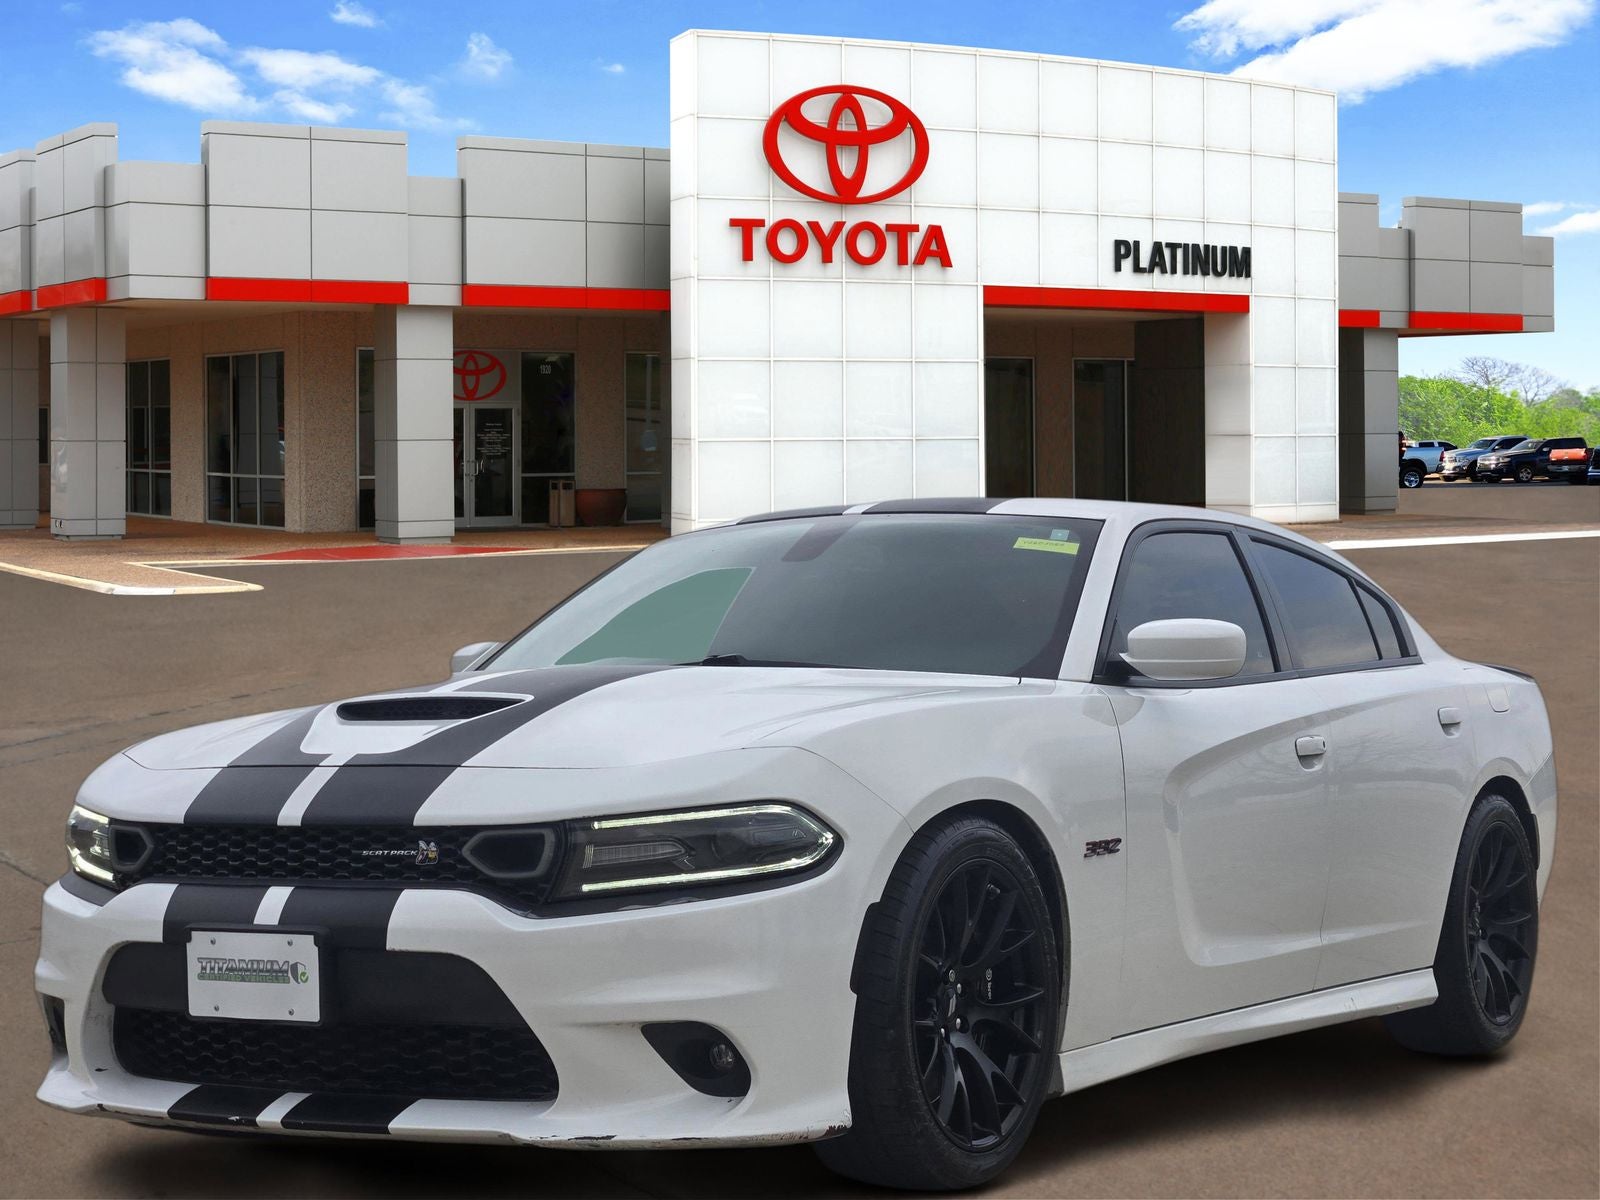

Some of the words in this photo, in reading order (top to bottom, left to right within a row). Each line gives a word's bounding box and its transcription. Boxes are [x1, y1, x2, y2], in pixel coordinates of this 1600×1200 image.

[729, 218, 953, 268] TOYOTA
[1114, 239, 1252, 278] PLATINUM
[1084, 837, 1122, 858] 392
[197, 957, 290, 977] TITANIUM
